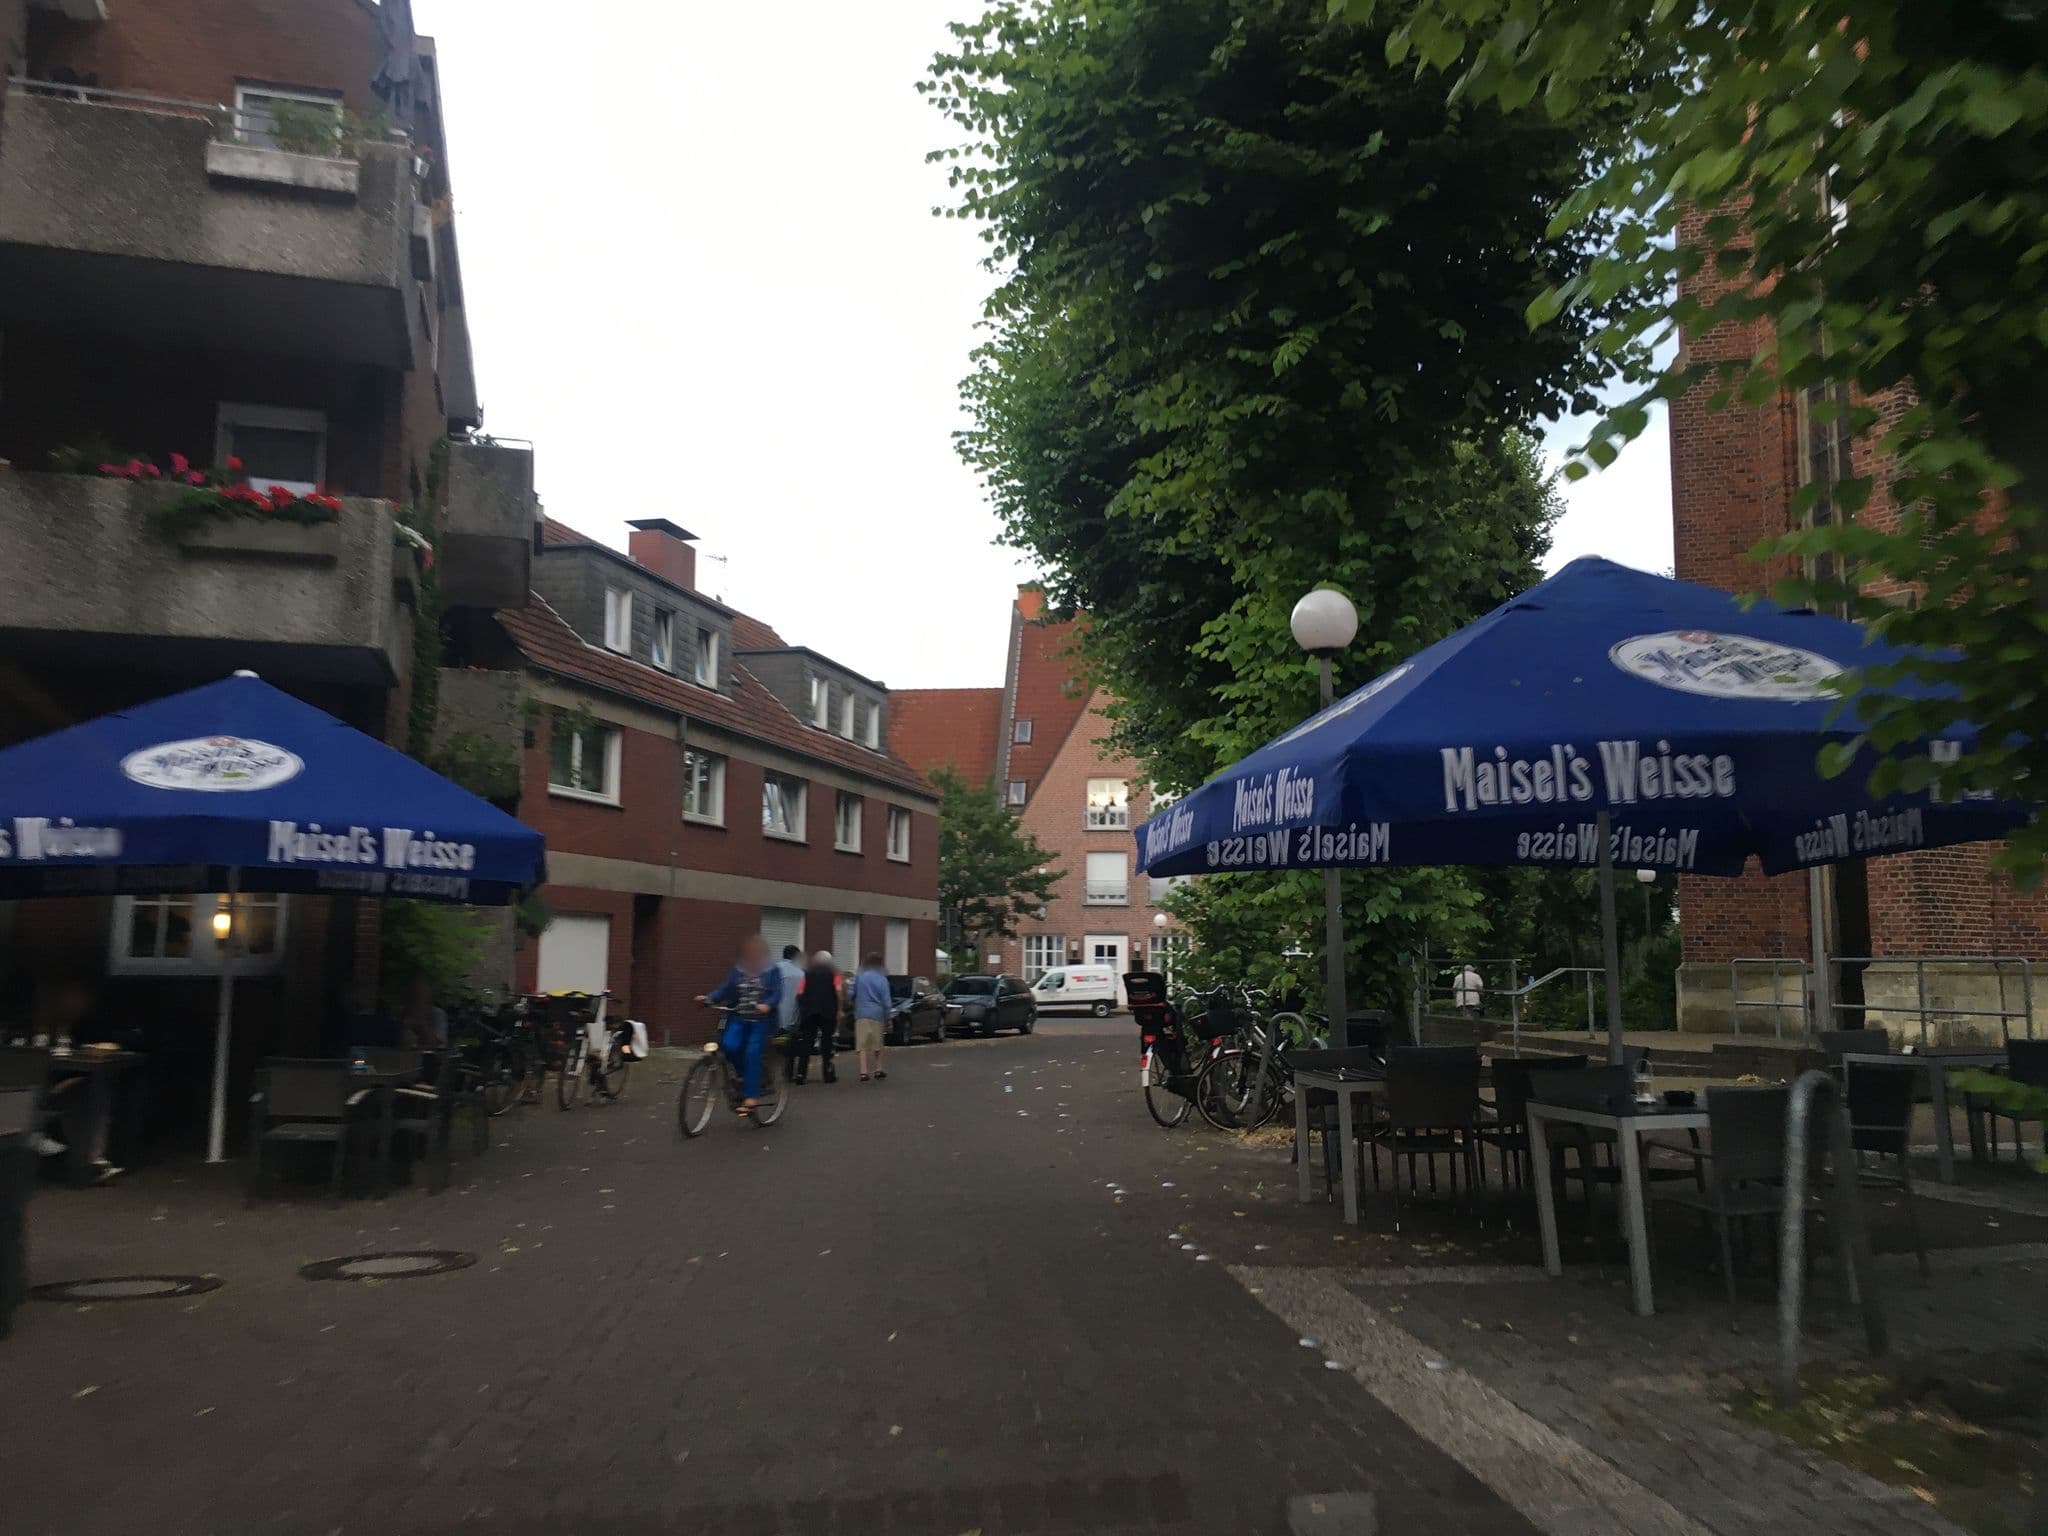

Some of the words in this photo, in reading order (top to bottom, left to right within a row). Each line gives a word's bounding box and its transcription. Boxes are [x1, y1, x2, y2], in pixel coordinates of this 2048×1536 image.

[1233, 773, 1273, 832] Maisel's
[1275, 765, 1314, 825] Weisse
[1440, 743, 1594, 812] Maisel's
[1597, 739, 1737, 804] Weisse
[267, 820, 378, 865] Maisel's
[383, 827, 476, 870] Weisse
